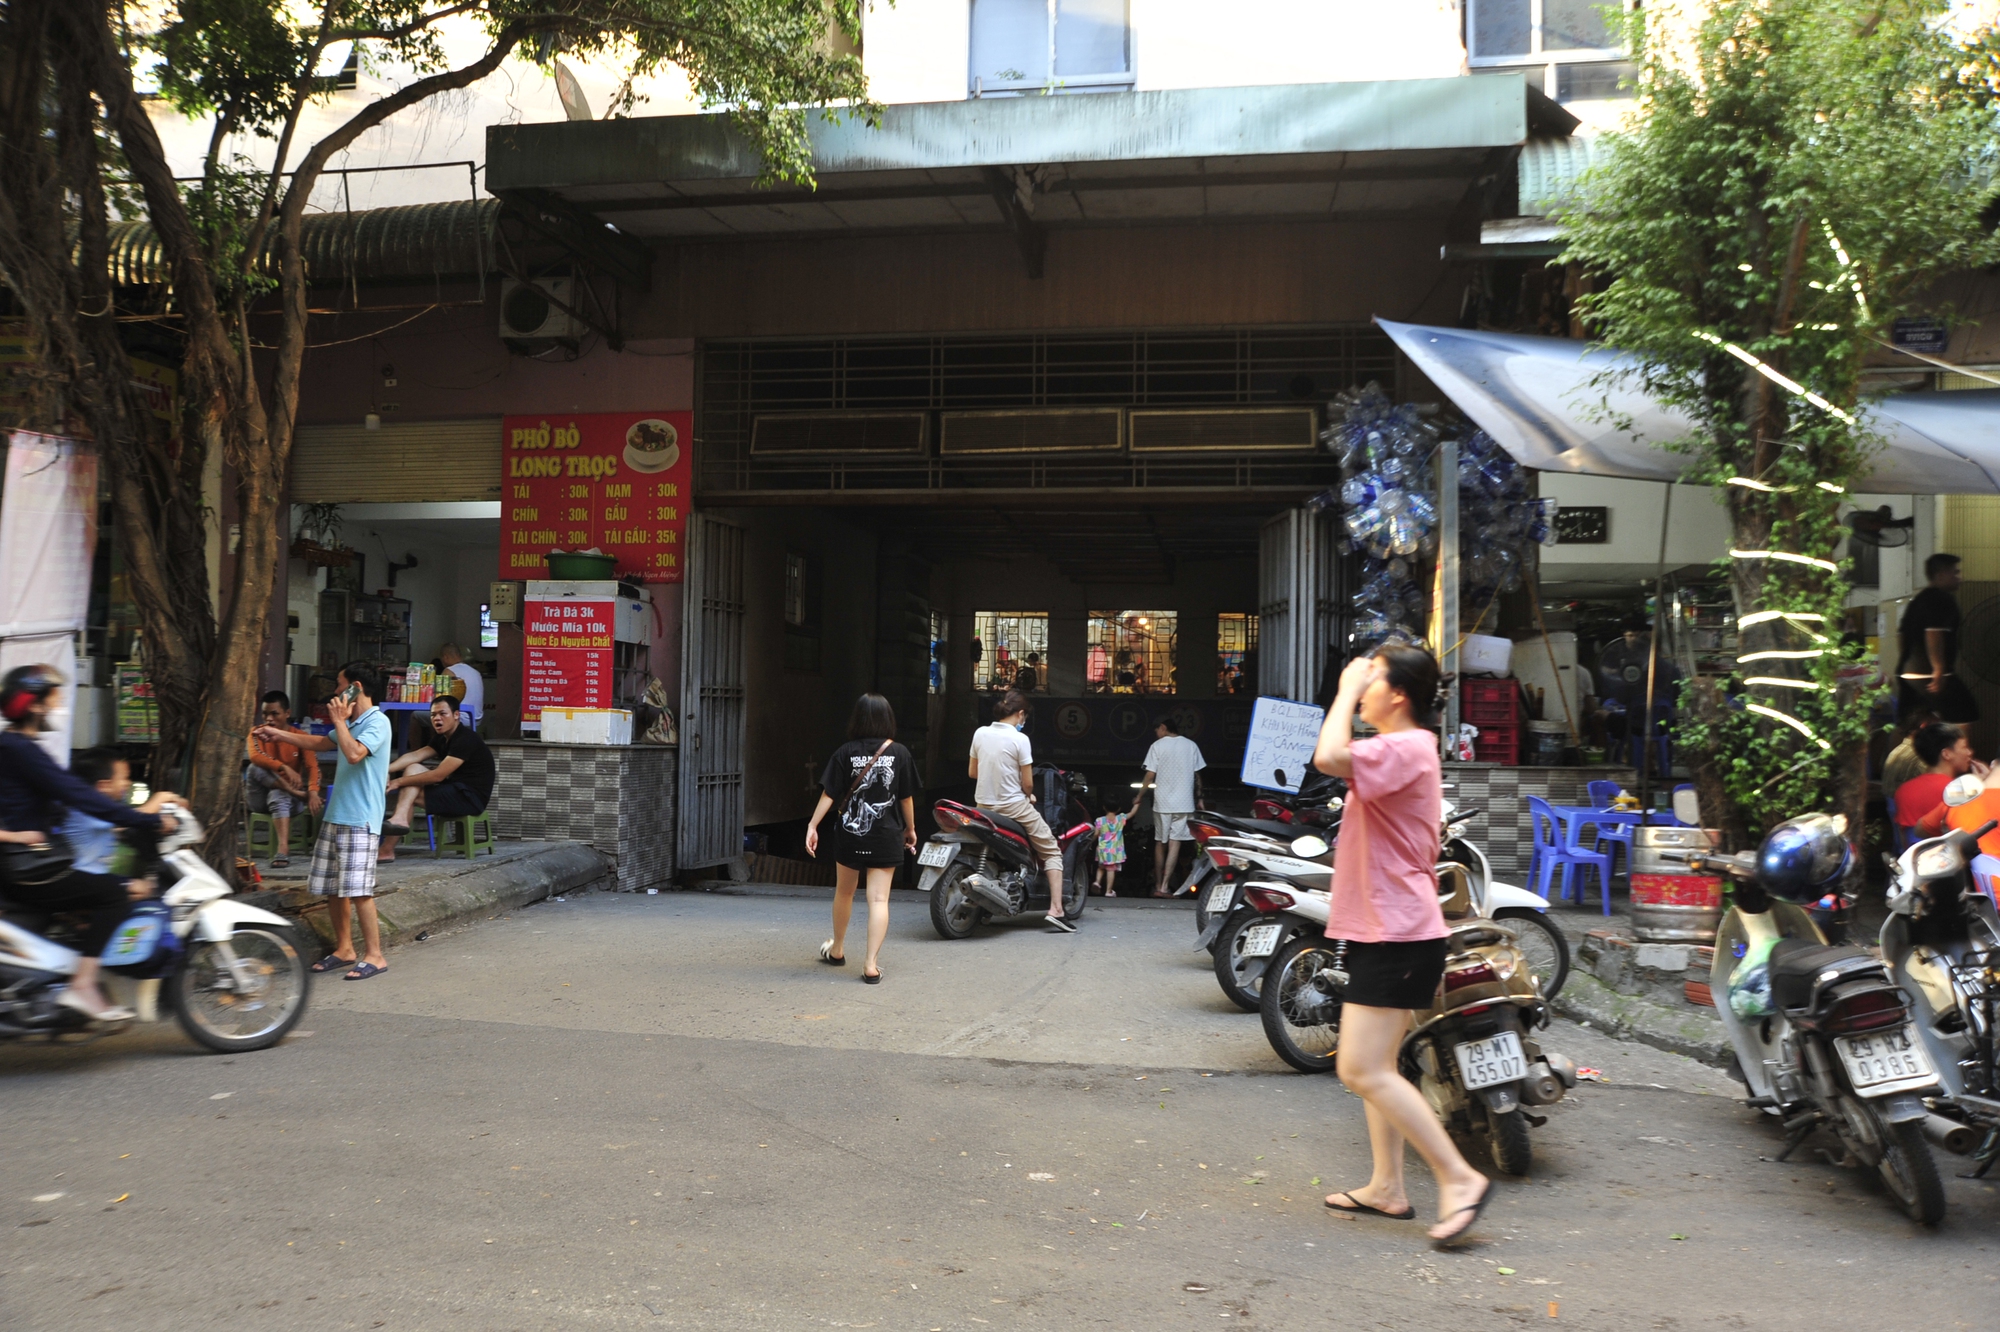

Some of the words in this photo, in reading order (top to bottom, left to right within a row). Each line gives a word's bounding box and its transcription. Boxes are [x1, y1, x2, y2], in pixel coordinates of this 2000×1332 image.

[511, 420, 551, 449] PHỞ
[553, 421, 581, 449] BÒ
[510, 456, 562, 478] LONG
[565, 455, 618, 482] TRỌC
[513, 482, 530, 499] TÁI
[569, 484, 589, 498] 30k
[657, 483, 677, 497] 30k
[512, 505, 538, 521] CHÍN
[568, 507, 588, 521] 30k
[656, 506, 677, 520] 30k
[511, 528, 528, 545] TÁI
[531, 528, 557, 545] CHÍN
[567, 530, 588, 545] 30k
[604, 527, 621, 544] TÁI
[656, 529, 677, 544] 35k
[510, 550, 540, 567] BÁNH
[655, 553, 676, 567] 30k
[543, 606, 561, 617] Trà
[563, 606, 577, 617] Đá
[580, 607, 594, 618] 3k
[531, 621, 559, 633] Nước
[562, 622, 583, 633] Mía
[586, 622, 606, 633] 10k
[526, 635, 547, 646] Nước
[561, 636, 591, 648] Nguyên
[592, 634, 611, 647] Chất
[1068, 709, 1078, 724] 5
[1121, 710, 1138, 733] P
[1467, 1056, 1520, 1085] 455.07
[1858, 1054, 1918, 1081] 0386
